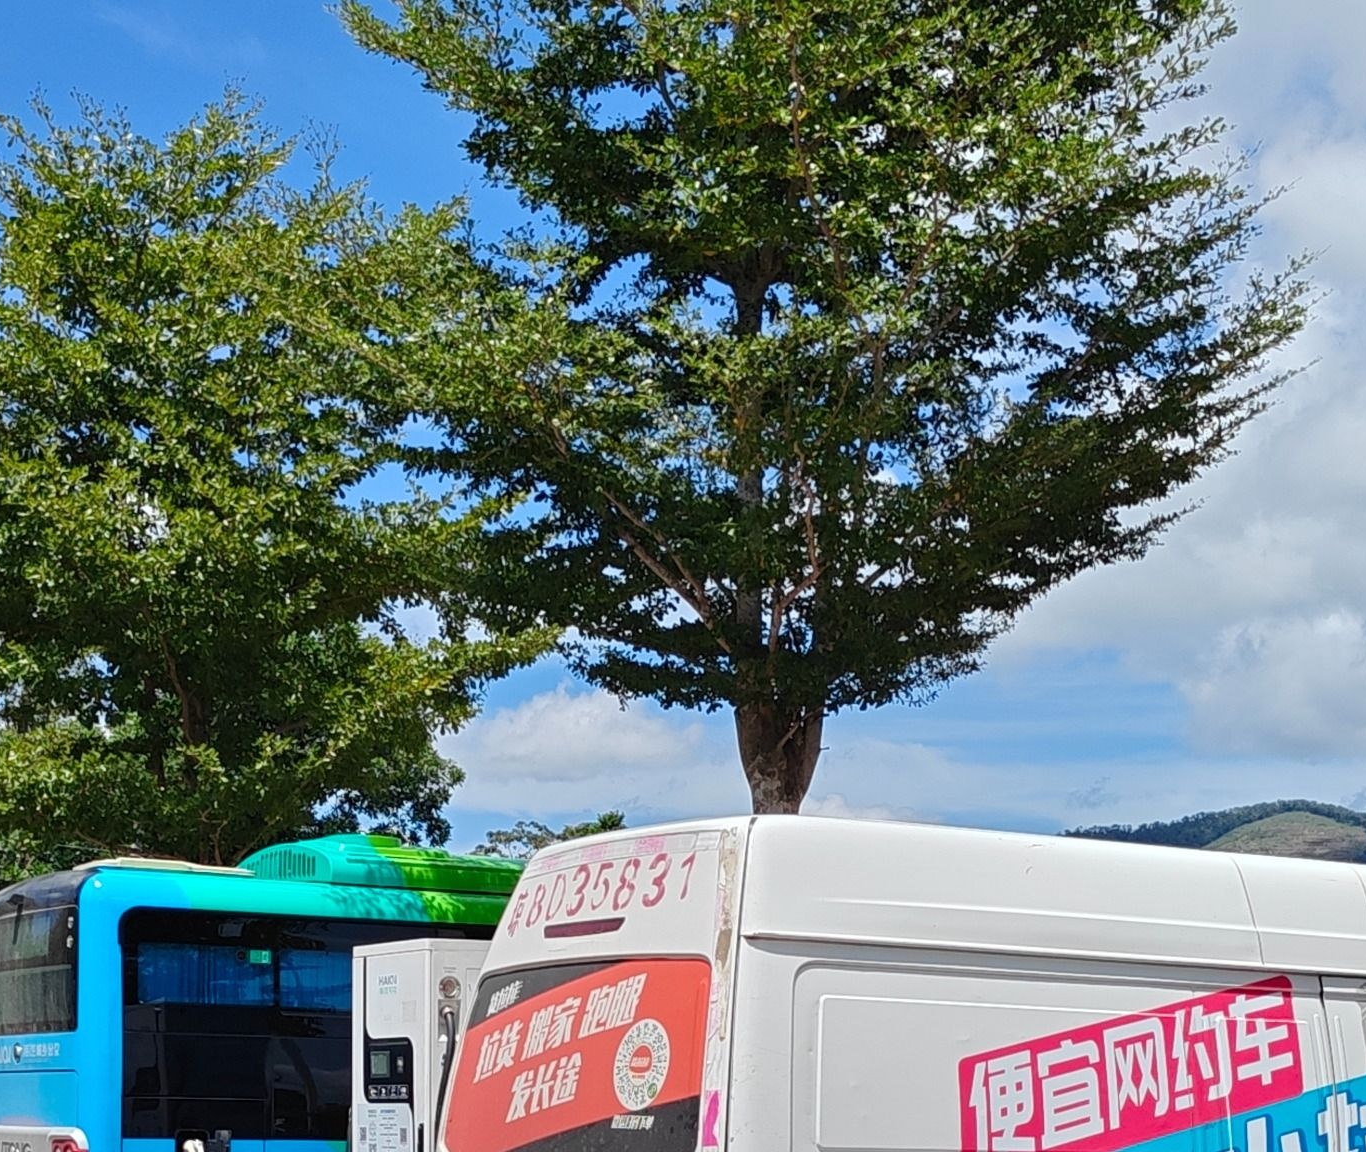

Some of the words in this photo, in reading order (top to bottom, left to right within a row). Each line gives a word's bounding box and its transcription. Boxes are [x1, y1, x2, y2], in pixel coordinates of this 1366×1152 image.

[473, 1019, 524, 1084] 拉货
[521, 996, 583, 1062] 搬家
[578, 972, 648, 1040] 跑腿
[505, 1051, 583, 1124] 发长途
